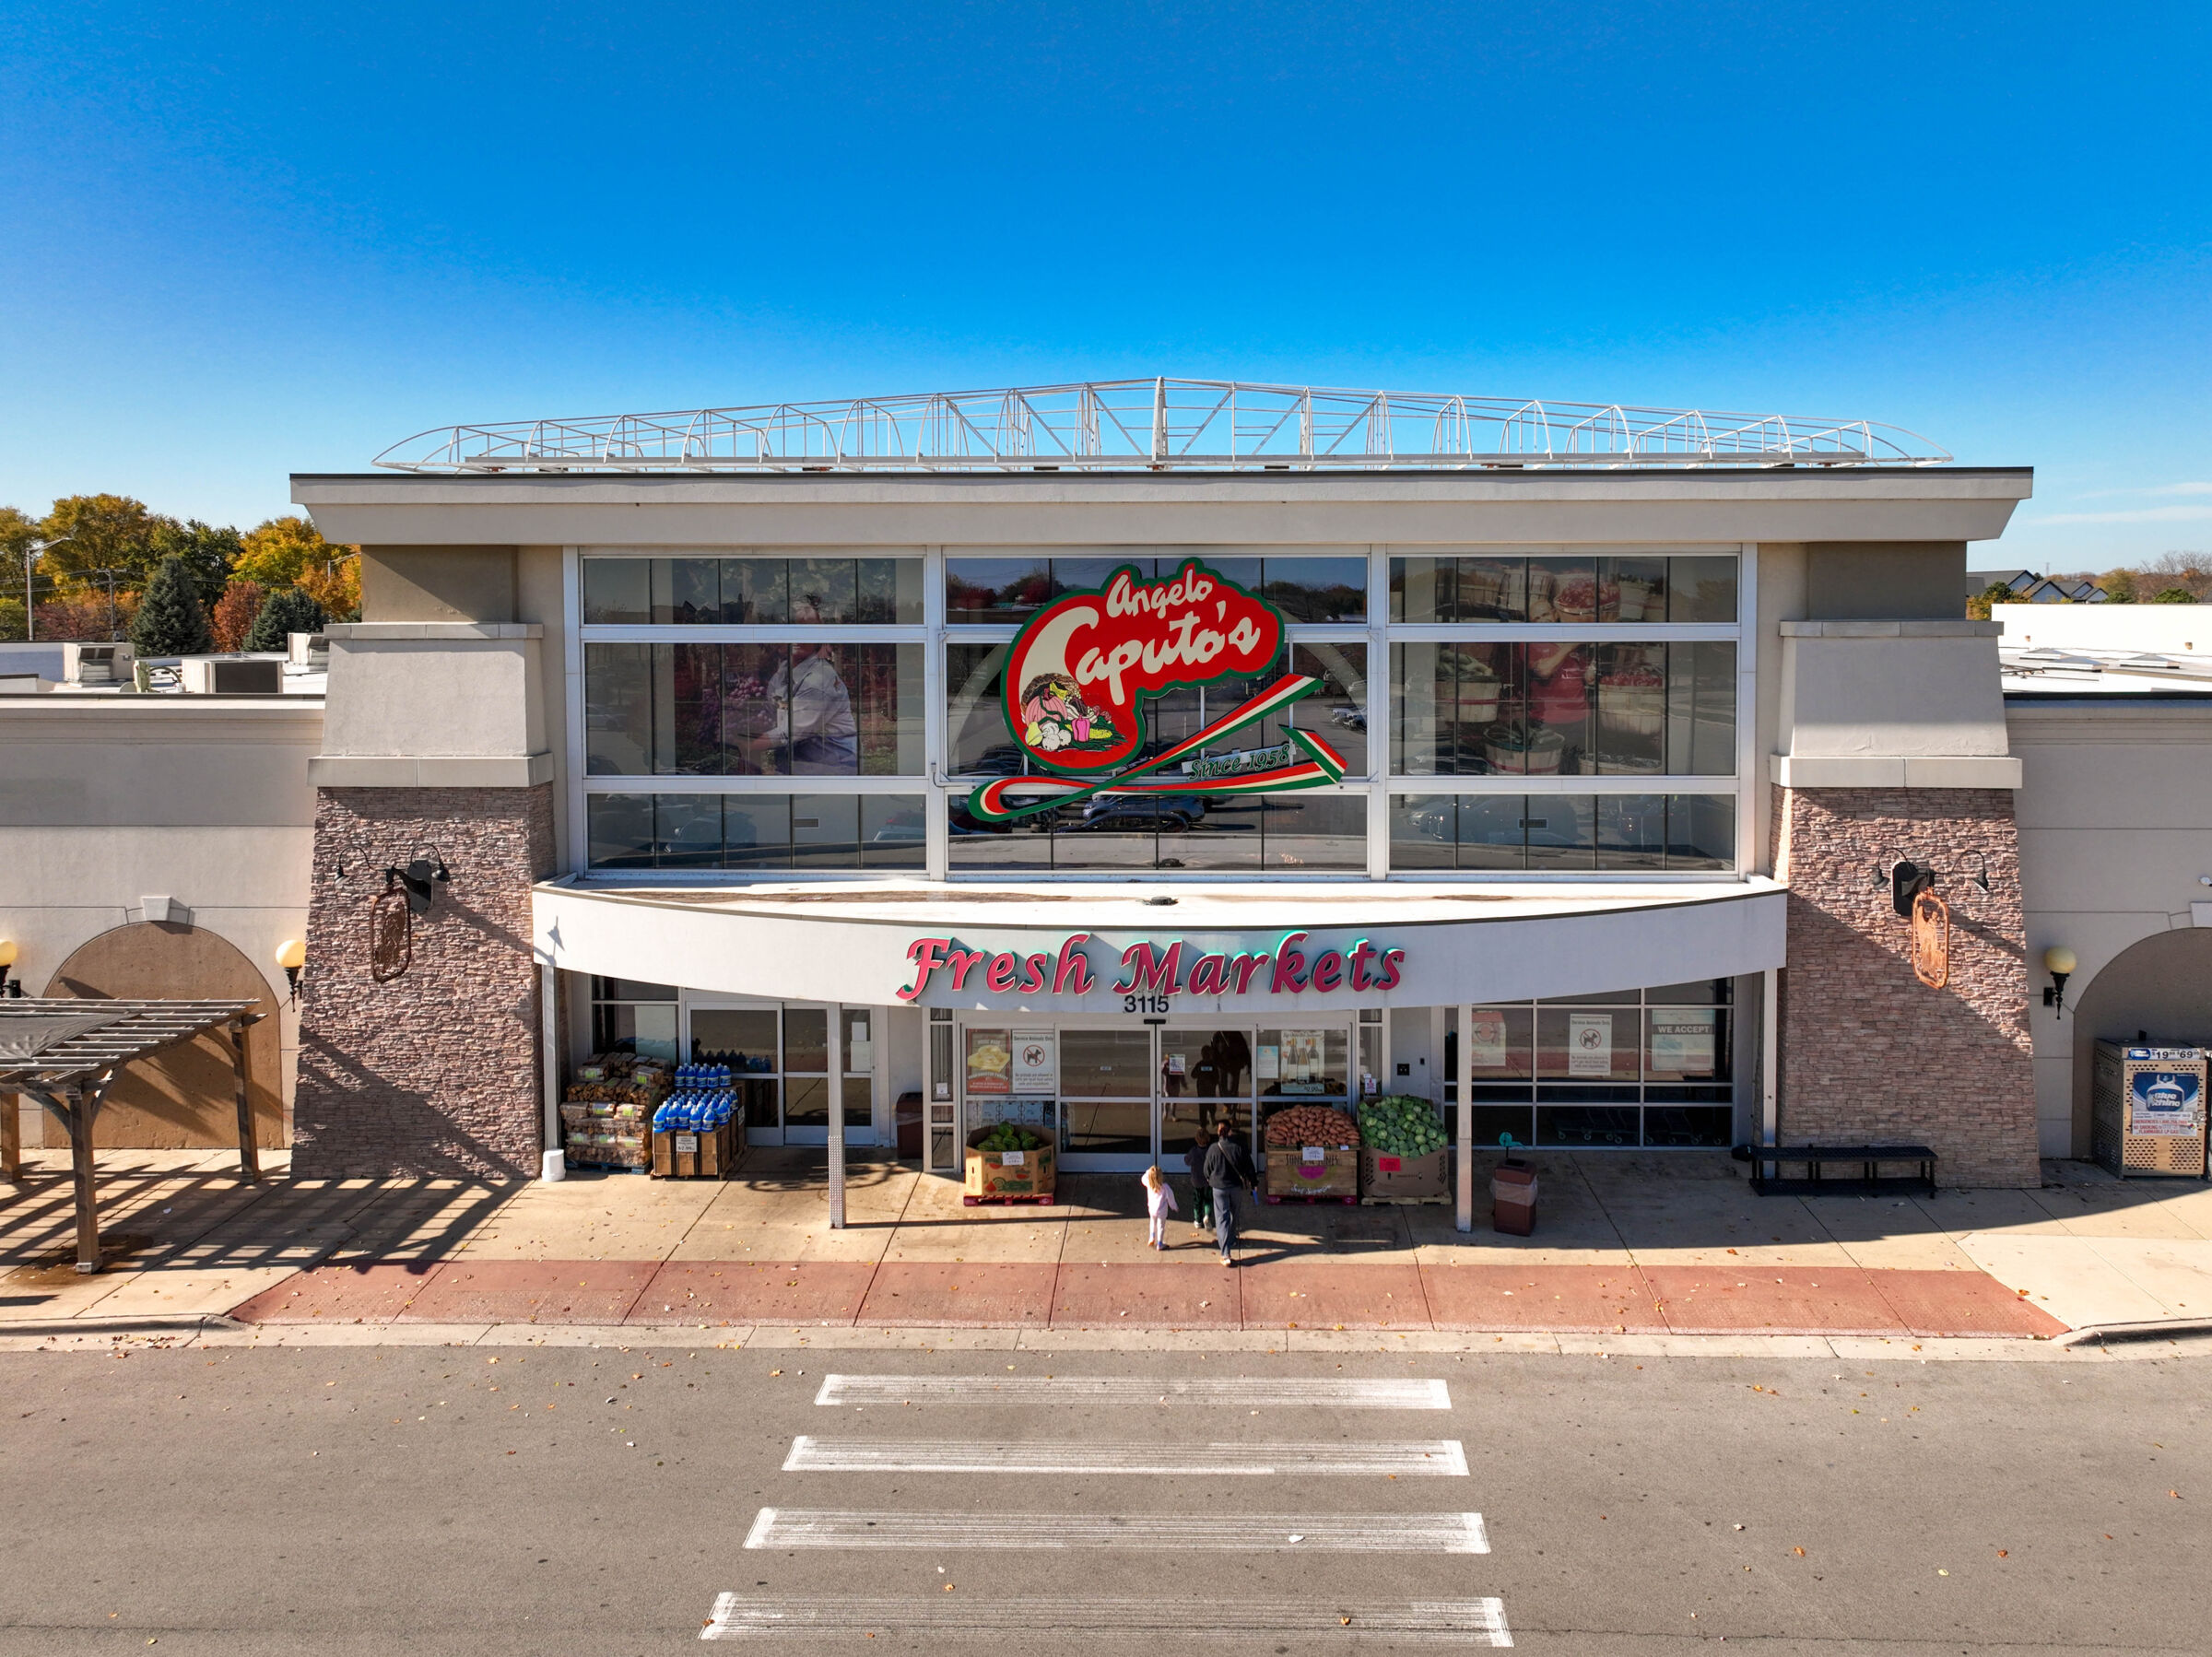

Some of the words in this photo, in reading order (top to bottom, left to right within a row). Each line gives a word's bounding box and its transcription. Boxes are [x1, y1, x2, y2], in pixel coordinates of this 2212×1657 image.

[1106, 569, 1213, 618] Angelo
[1019, 605, 1261, 705] Caputo's
[1188, 755, 1241, 781] Since
[1247, 743, 1290, 772] 1958
[895, 933, 1095, 1001] Fresh
[1112, 930, 1406, 997] Markets
[1124, 996, 1170, 1013] 3115
